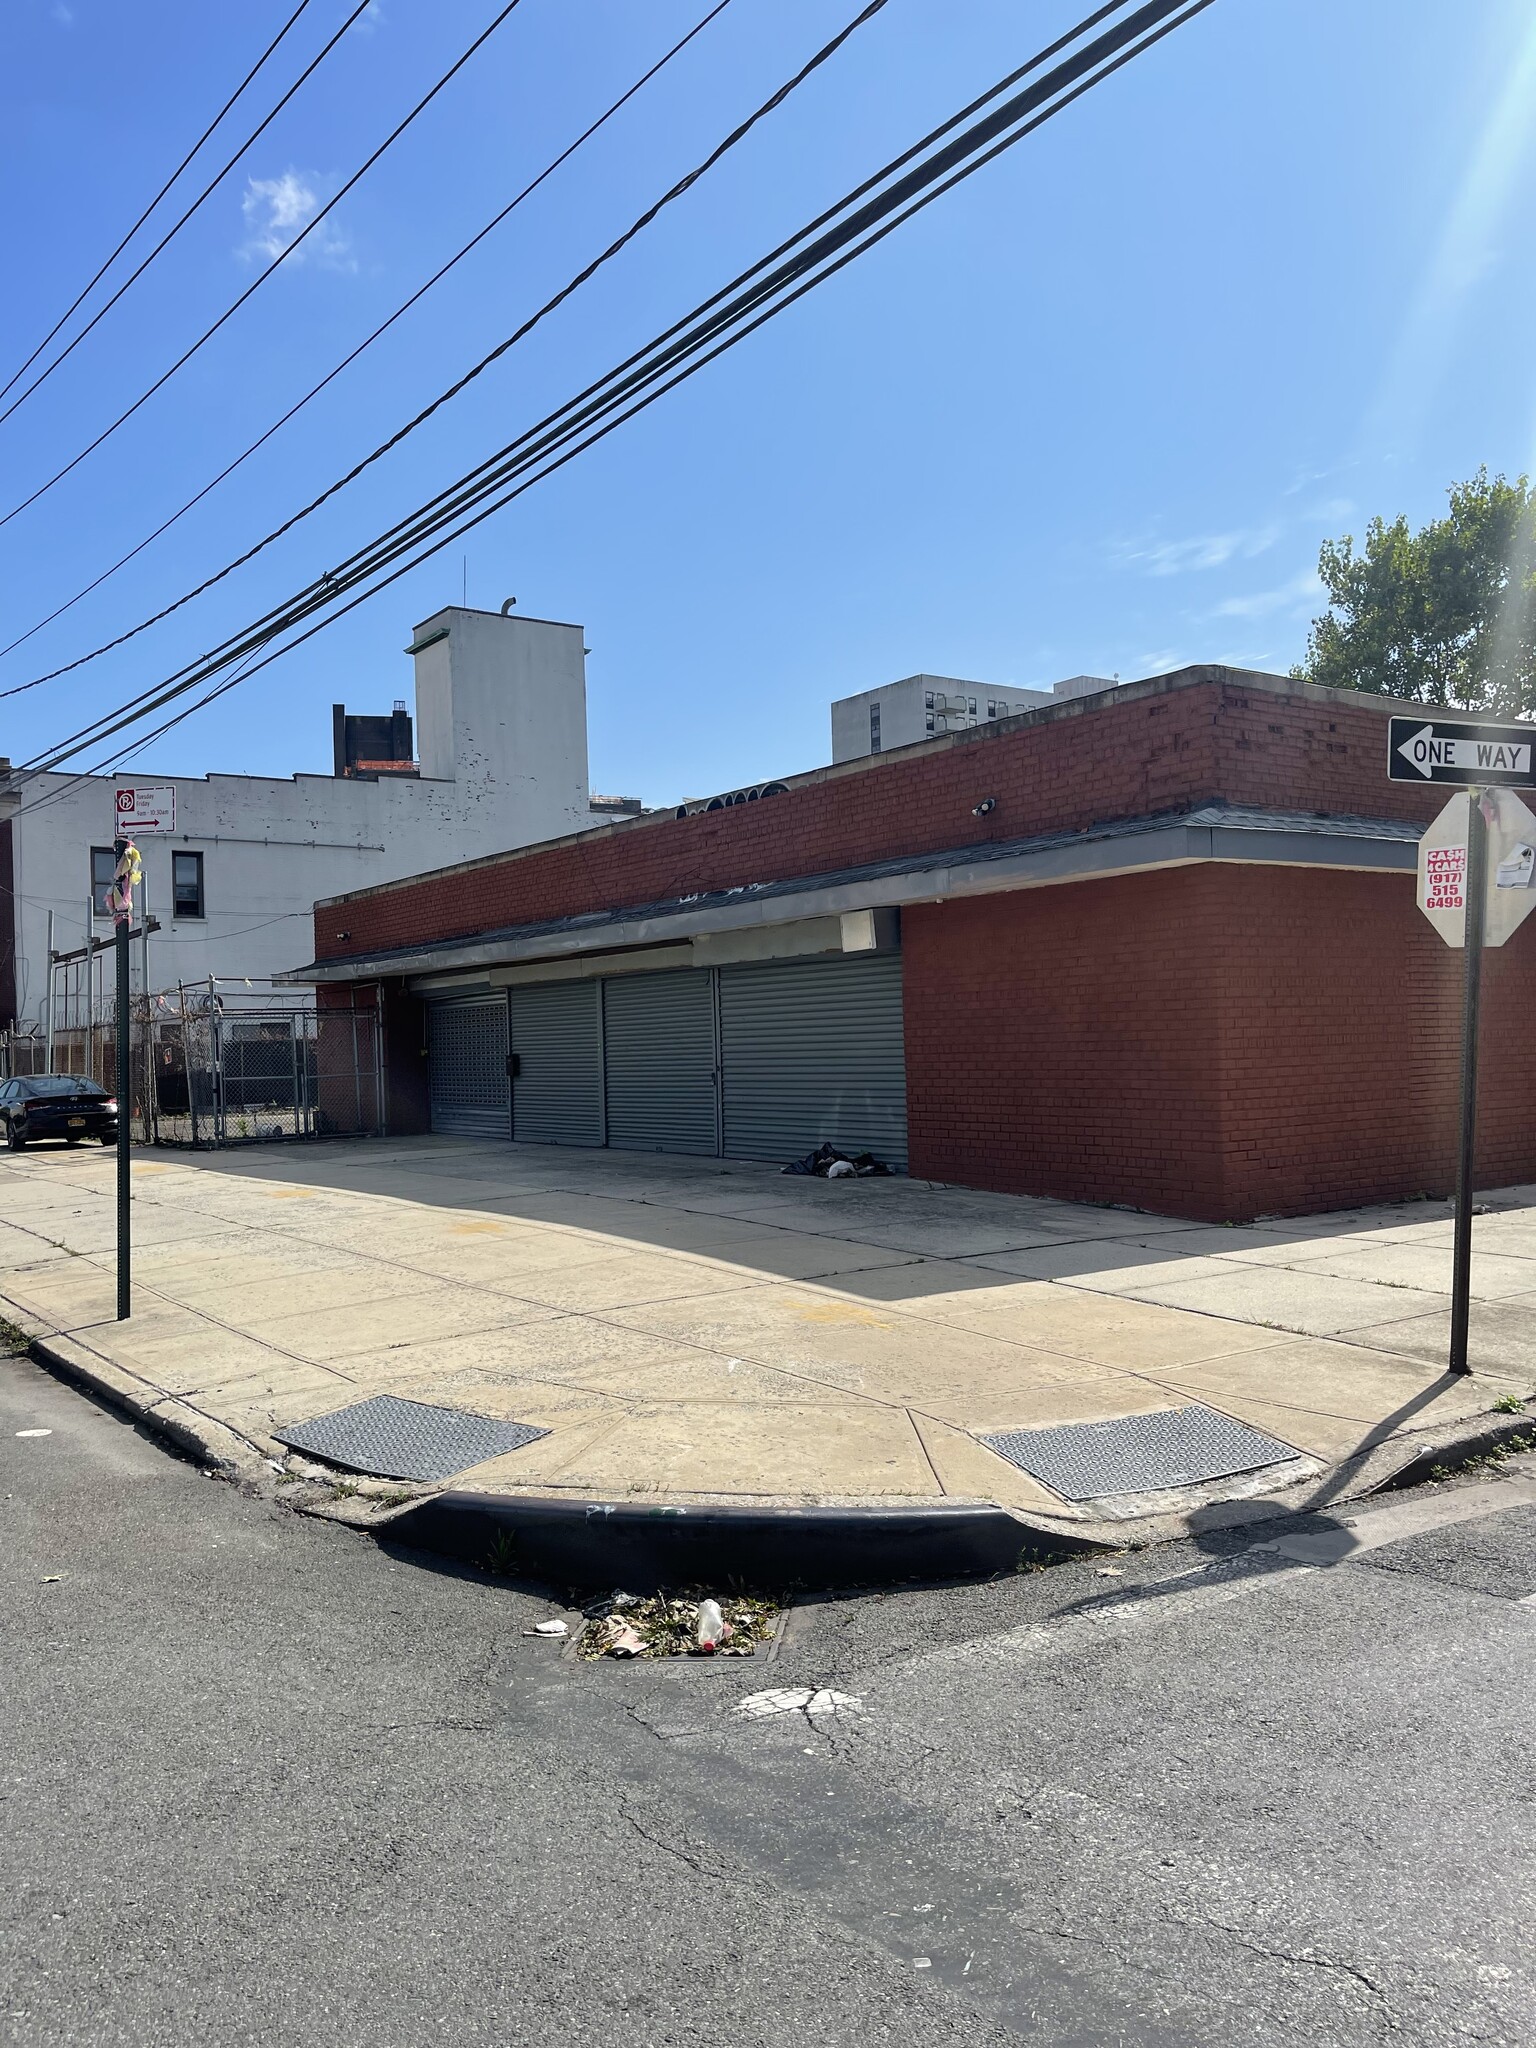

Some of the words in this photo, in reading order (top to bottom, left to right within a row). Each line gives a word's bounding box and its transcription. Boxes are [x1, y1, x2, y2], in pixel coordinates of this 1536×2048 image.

[1413, 739, 1456, 765] ONE
[1477, 744, 1522, 769] WAY
[1429, 872, 1462, 884] (917)
[1432, 884, 1459, 896] 515
[1426, 896, 1463, 909] 6499
